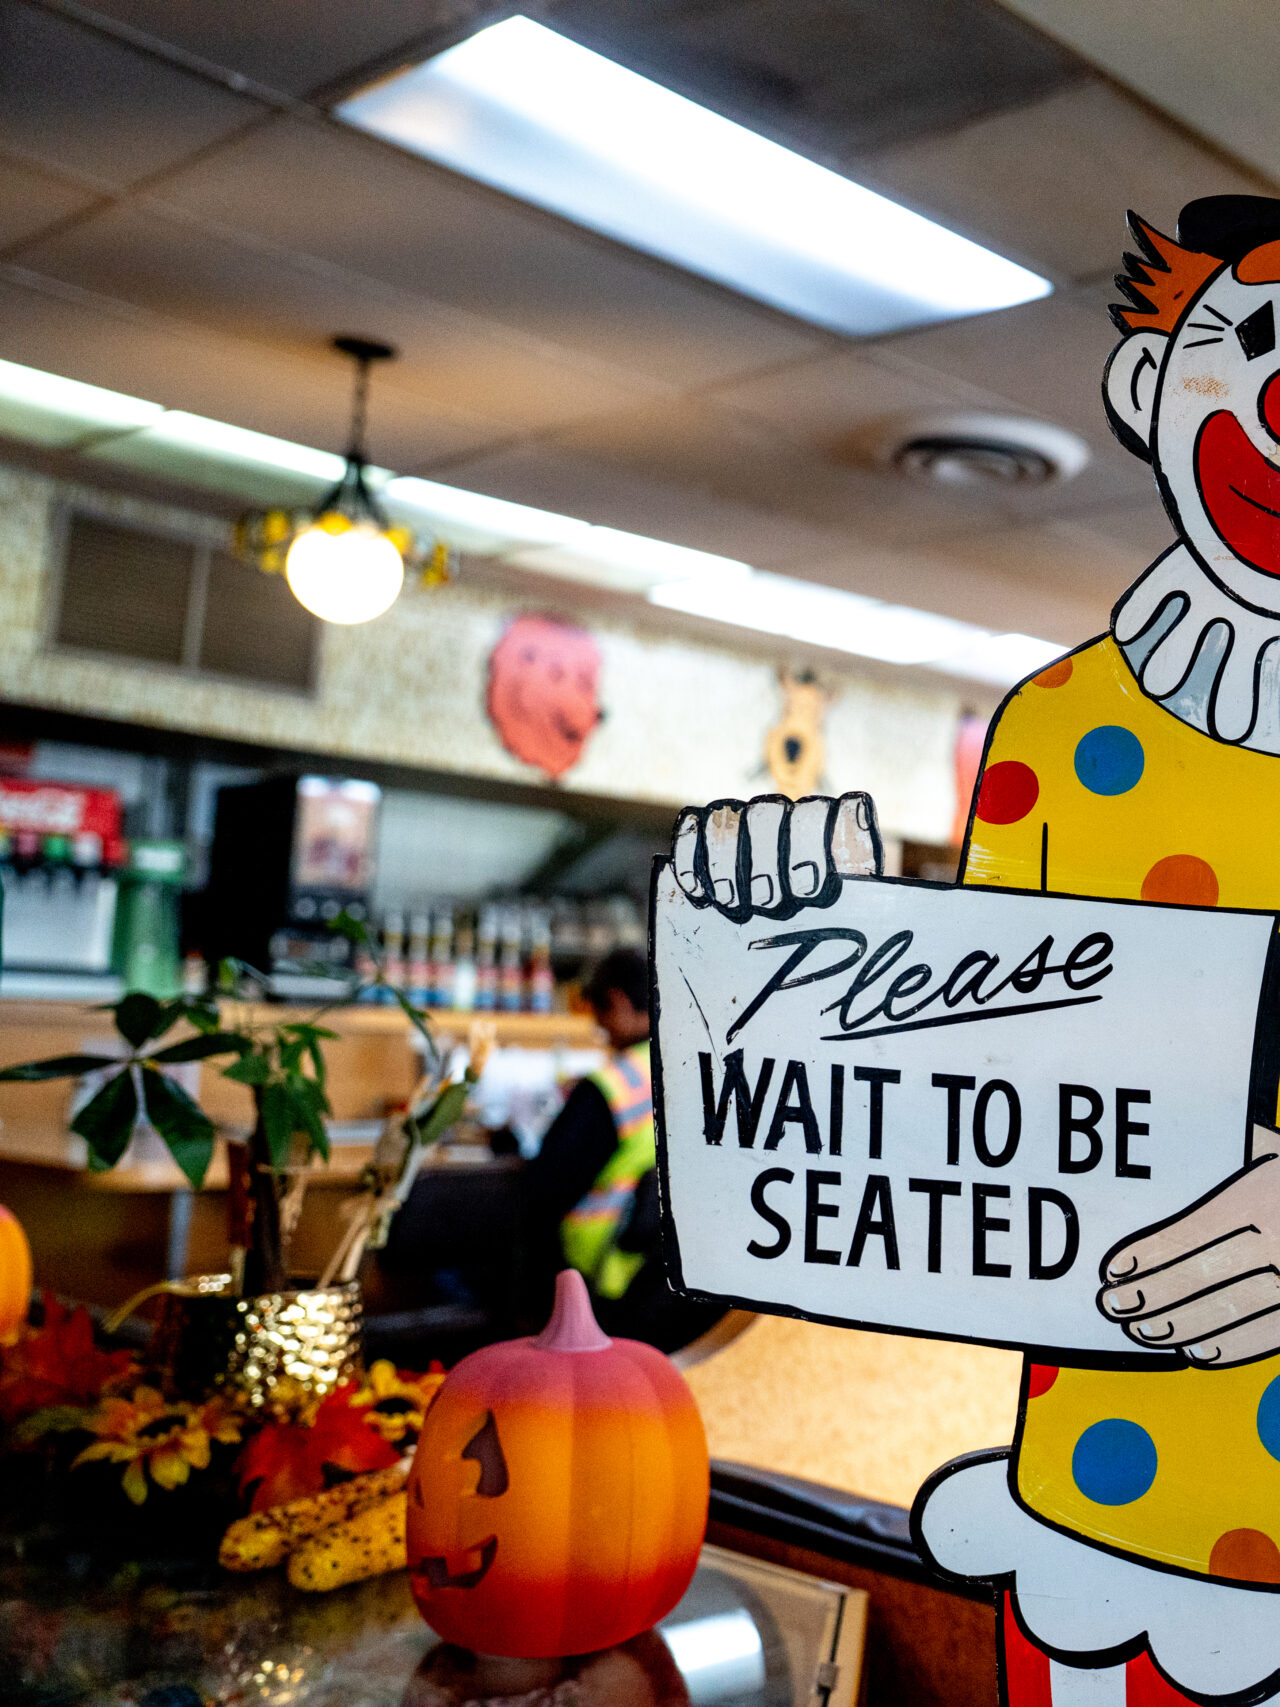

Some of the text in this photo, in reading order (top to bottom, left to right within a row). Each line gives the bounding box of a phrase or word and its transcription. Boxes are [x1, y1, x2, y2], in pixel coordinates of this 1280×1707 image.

[726, 928, 1114, 1045] Please
[698, 1048, 1152, 1180] WAIT TO BE
[746, 1167, 1080, 1280] SEATED
